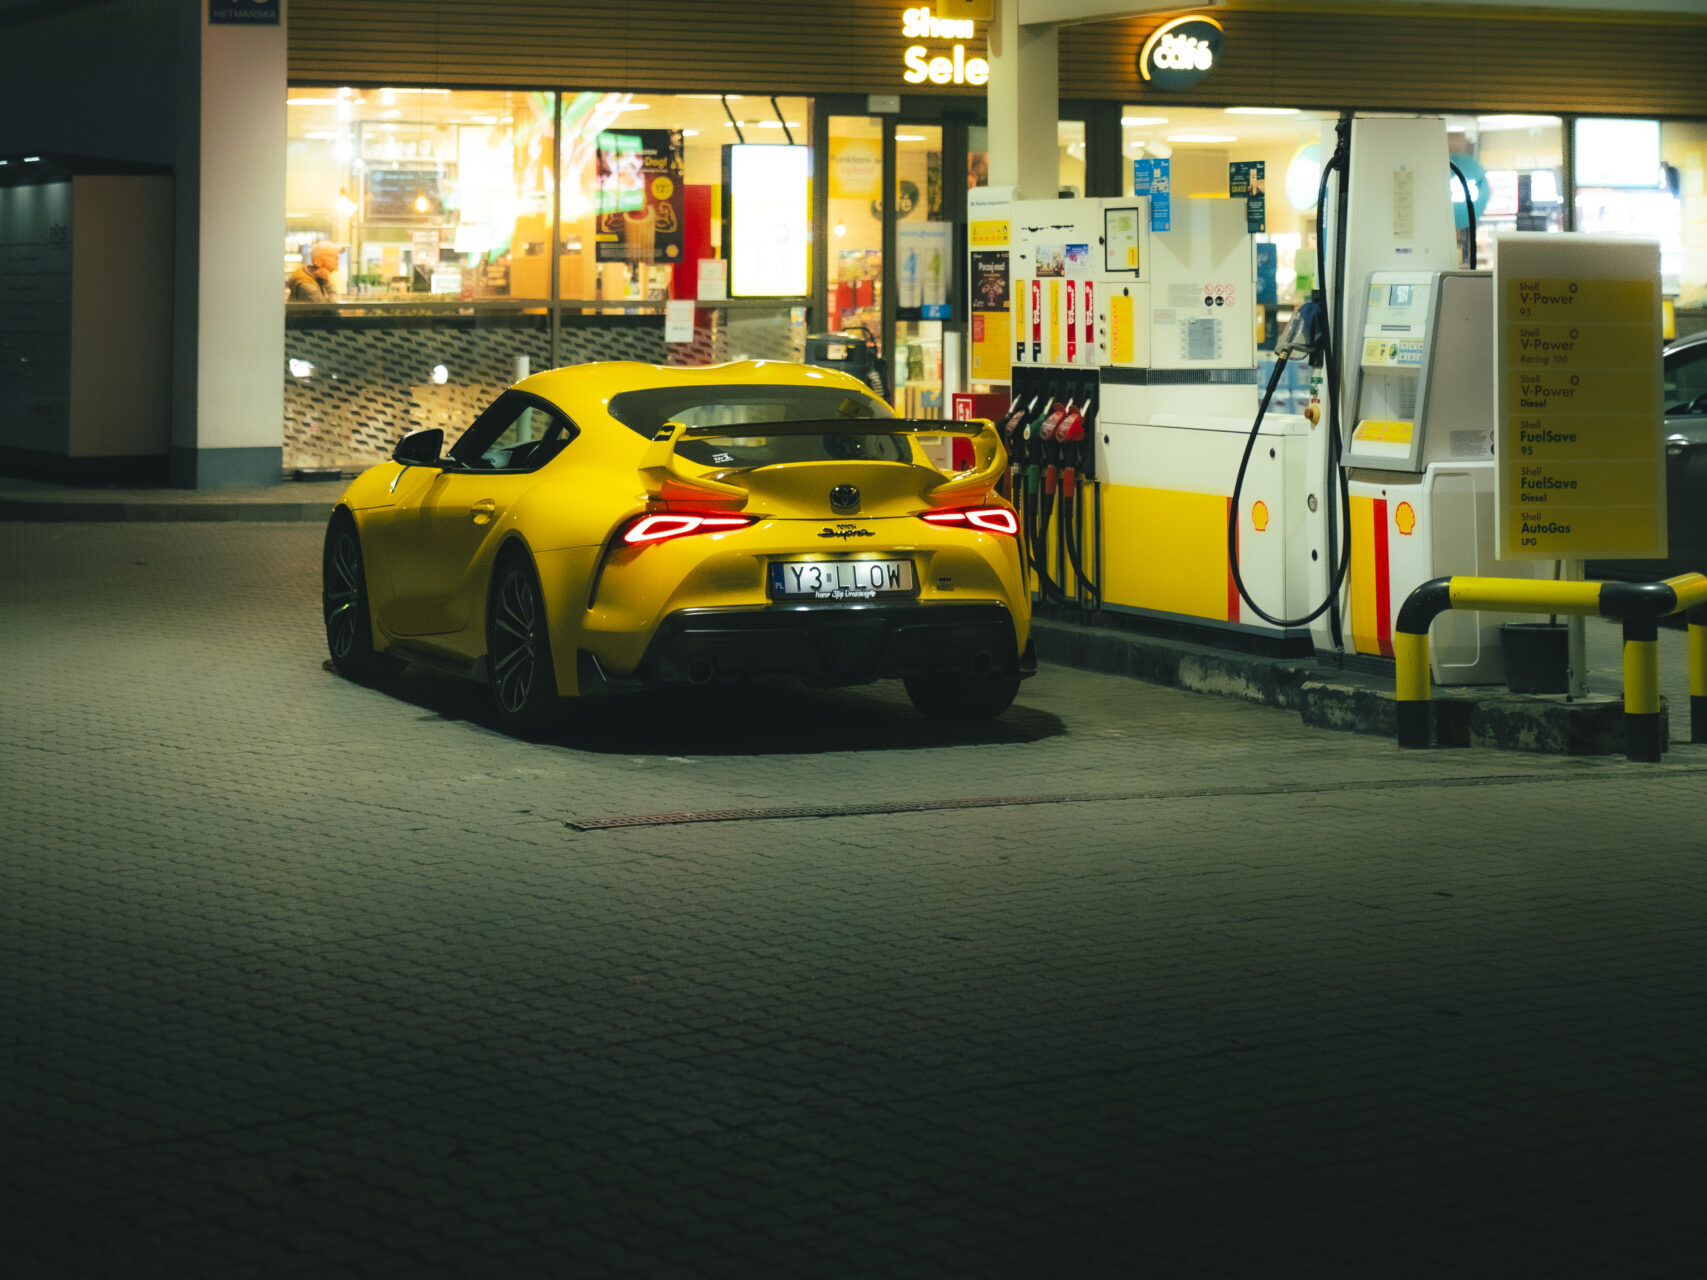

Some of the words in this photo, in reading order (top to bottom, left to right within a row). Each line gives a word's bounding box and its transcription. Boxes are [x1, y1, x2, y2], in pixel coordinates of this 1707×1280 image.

[213, 7, 276, 19] HETMAŃSKA
[1519, 282, 1540, 291] Shell
[1519, 293, 1575, 305] V-Power
[1520, 308, 1532, 317] 95
[1519, 328, 1540, 337] Shell
[1520, 339, 1575, 351] V-Power
[1520, 354, 1550, 366] Racing
[1553, 355, 1568, 364] 100
[1520, 374, 1541, 384] Shell
[1521, 385, 1575, 397] V-Power
[1520, 398, 1547, 408] Diesel
[1520, 420, 1541, 430] Shell
[1519, 430, 1577, 443] FuelSave
[1520, 446, 1534, 456] 95
[1520, 466, 1542, 476] Shell
[1520, 477, 1578, 490] FuelSave
[1520, 493, 1547, 502] Diesel
[1520, 512, 1542, 521] Shell
[1520, 522, 1571, 534] AutoGas
[817, 527, 875, 542] Supra
[1521, 537, 1537, 546] LPG
[791, 565, 823, 592] Y3
[836, 563, 901, 590] LLOW
[774, 582, 785, 590] PL
